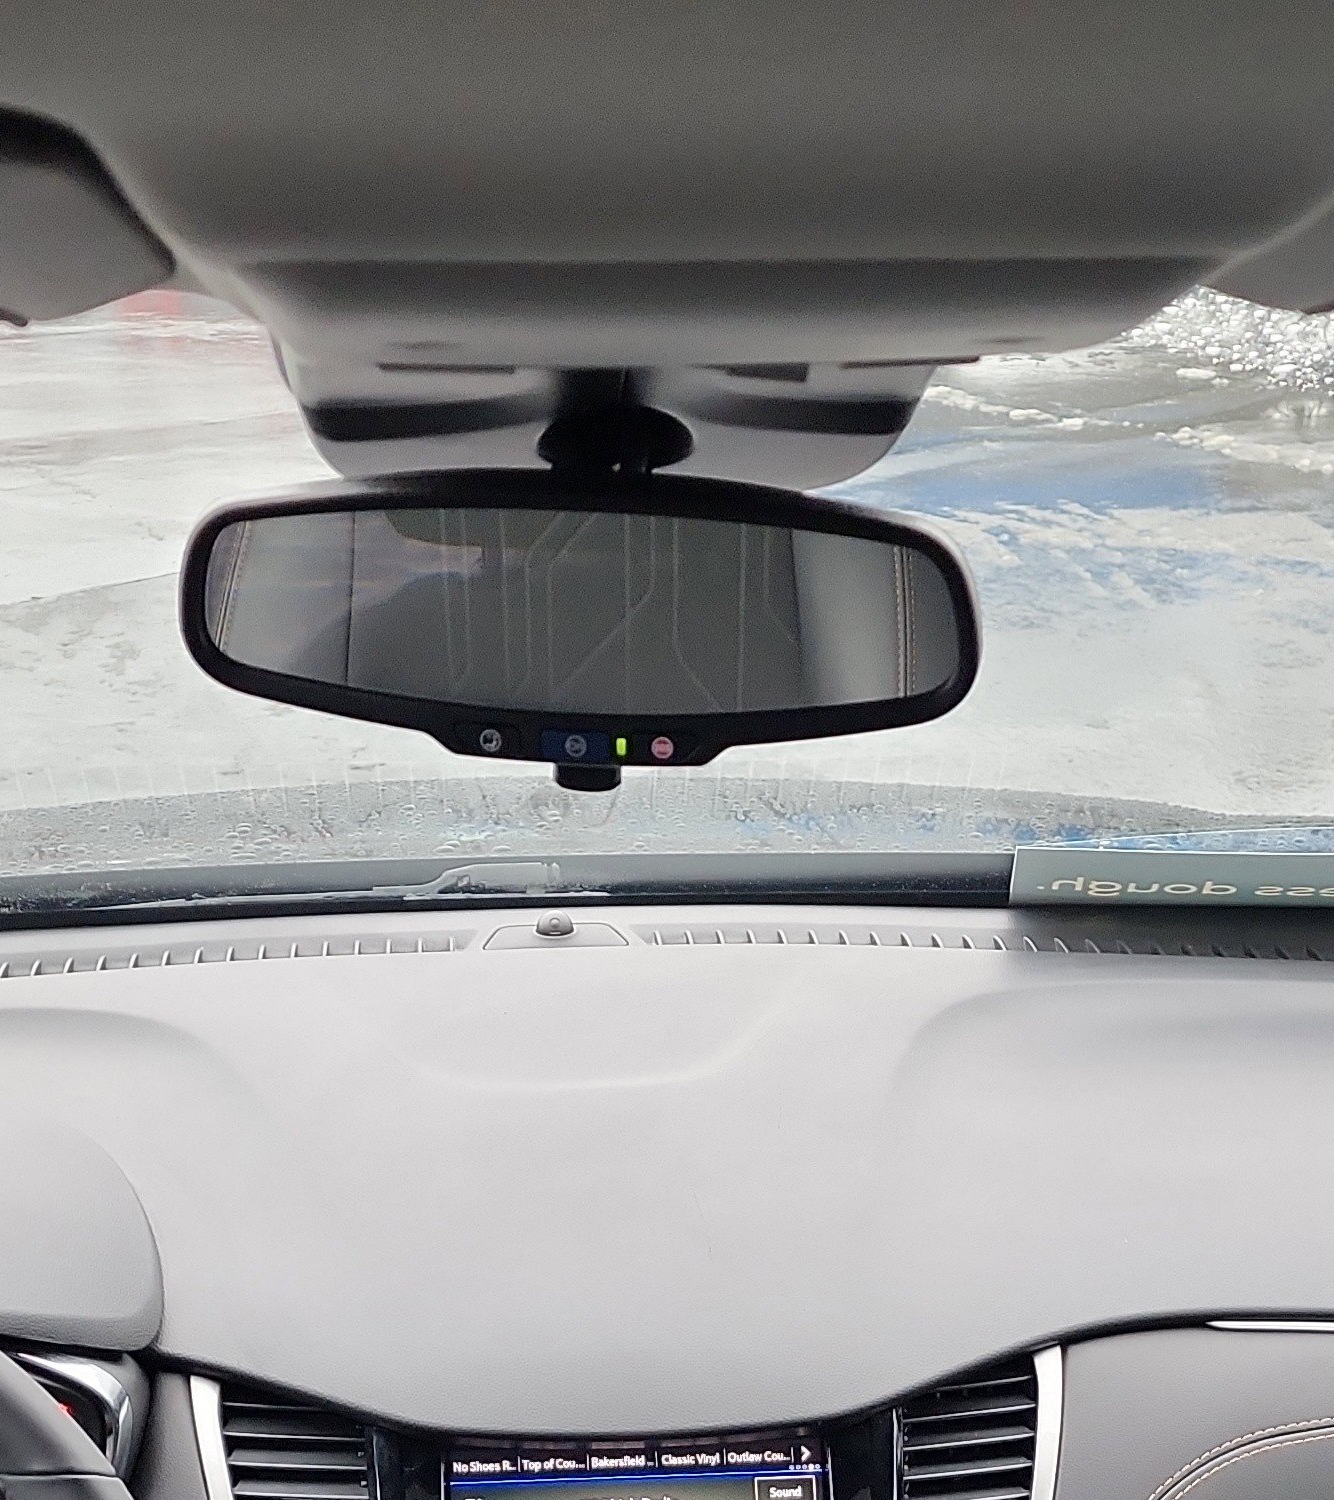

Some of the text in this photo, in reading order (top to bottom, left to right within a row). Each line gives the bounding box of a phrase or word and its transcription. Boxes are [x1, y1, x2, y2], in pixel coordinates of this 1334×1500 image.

[469, 1460, 501, 1472] Shoes
[522, 1459, 542, 1472] Top
[543, 1457, 555, 1470] of
[769, 1485, 803, 1498] Sound
